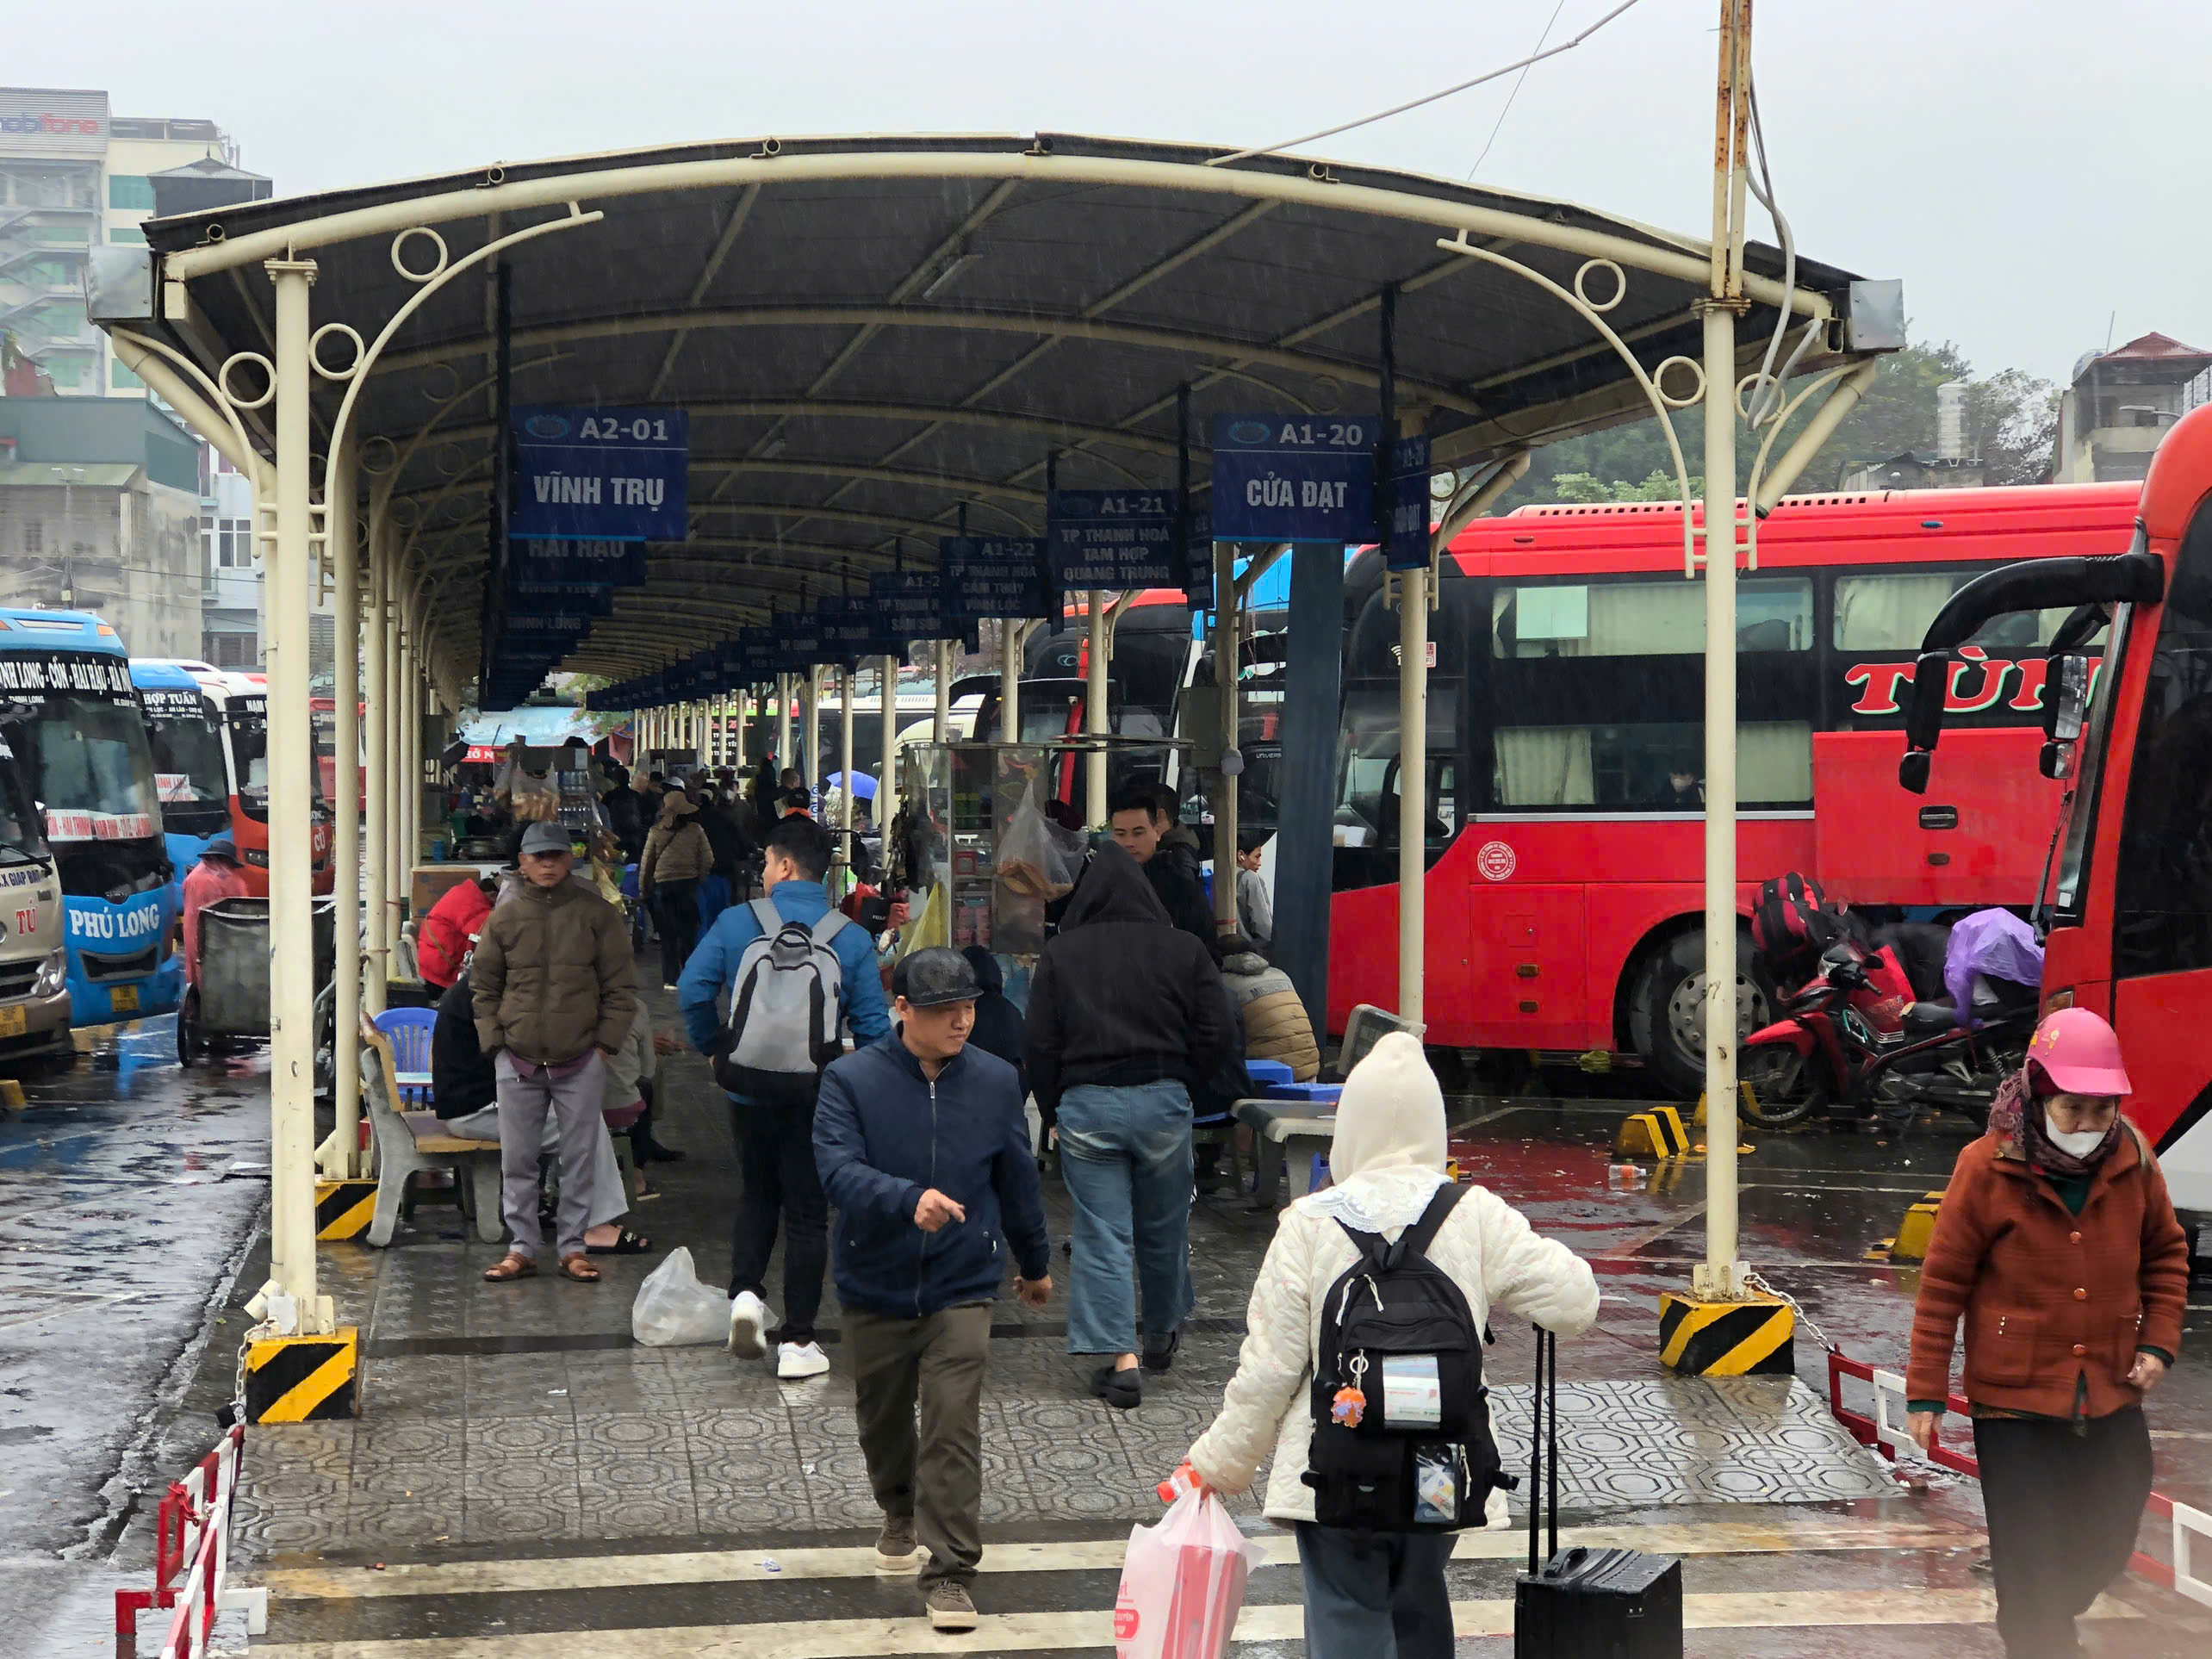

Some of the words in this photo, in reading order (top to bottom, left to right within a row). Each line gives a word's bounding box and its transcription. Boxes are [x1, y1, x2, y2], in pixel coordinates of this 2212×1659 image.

[580, 417, 668, 441] A2-01
[1279, 423, 1364, 446] A1-20
[533, 470, 601, 505] VĨNH
[610, 477, 664, 512] TRỤ
[1246, 470, 1296, 507] CỬA
[1302, 481, 1348, 514] ĐẠT
[1100, 496, 1165, 514] A1-21
[1061, 529, 1081, 543] TP
[1084, 528, 1135, 543] THANH
[981, 542, 1035, 557] A1-22
[1083, 547, 1114, 562] TAM
[1118, 544, 1150, 564] HỢP
[906, 576, 941, 587] A1-2
[1064, 566, 1115, 582] QUANG
[1120, 566, 1170, 580] TRUNG
[16, 662, 45, 689] LONG
[245, 699, 265, 712] NAM
[69, 905, 114, 939] PHÚ
[116, 903, 161, 938] LONG
